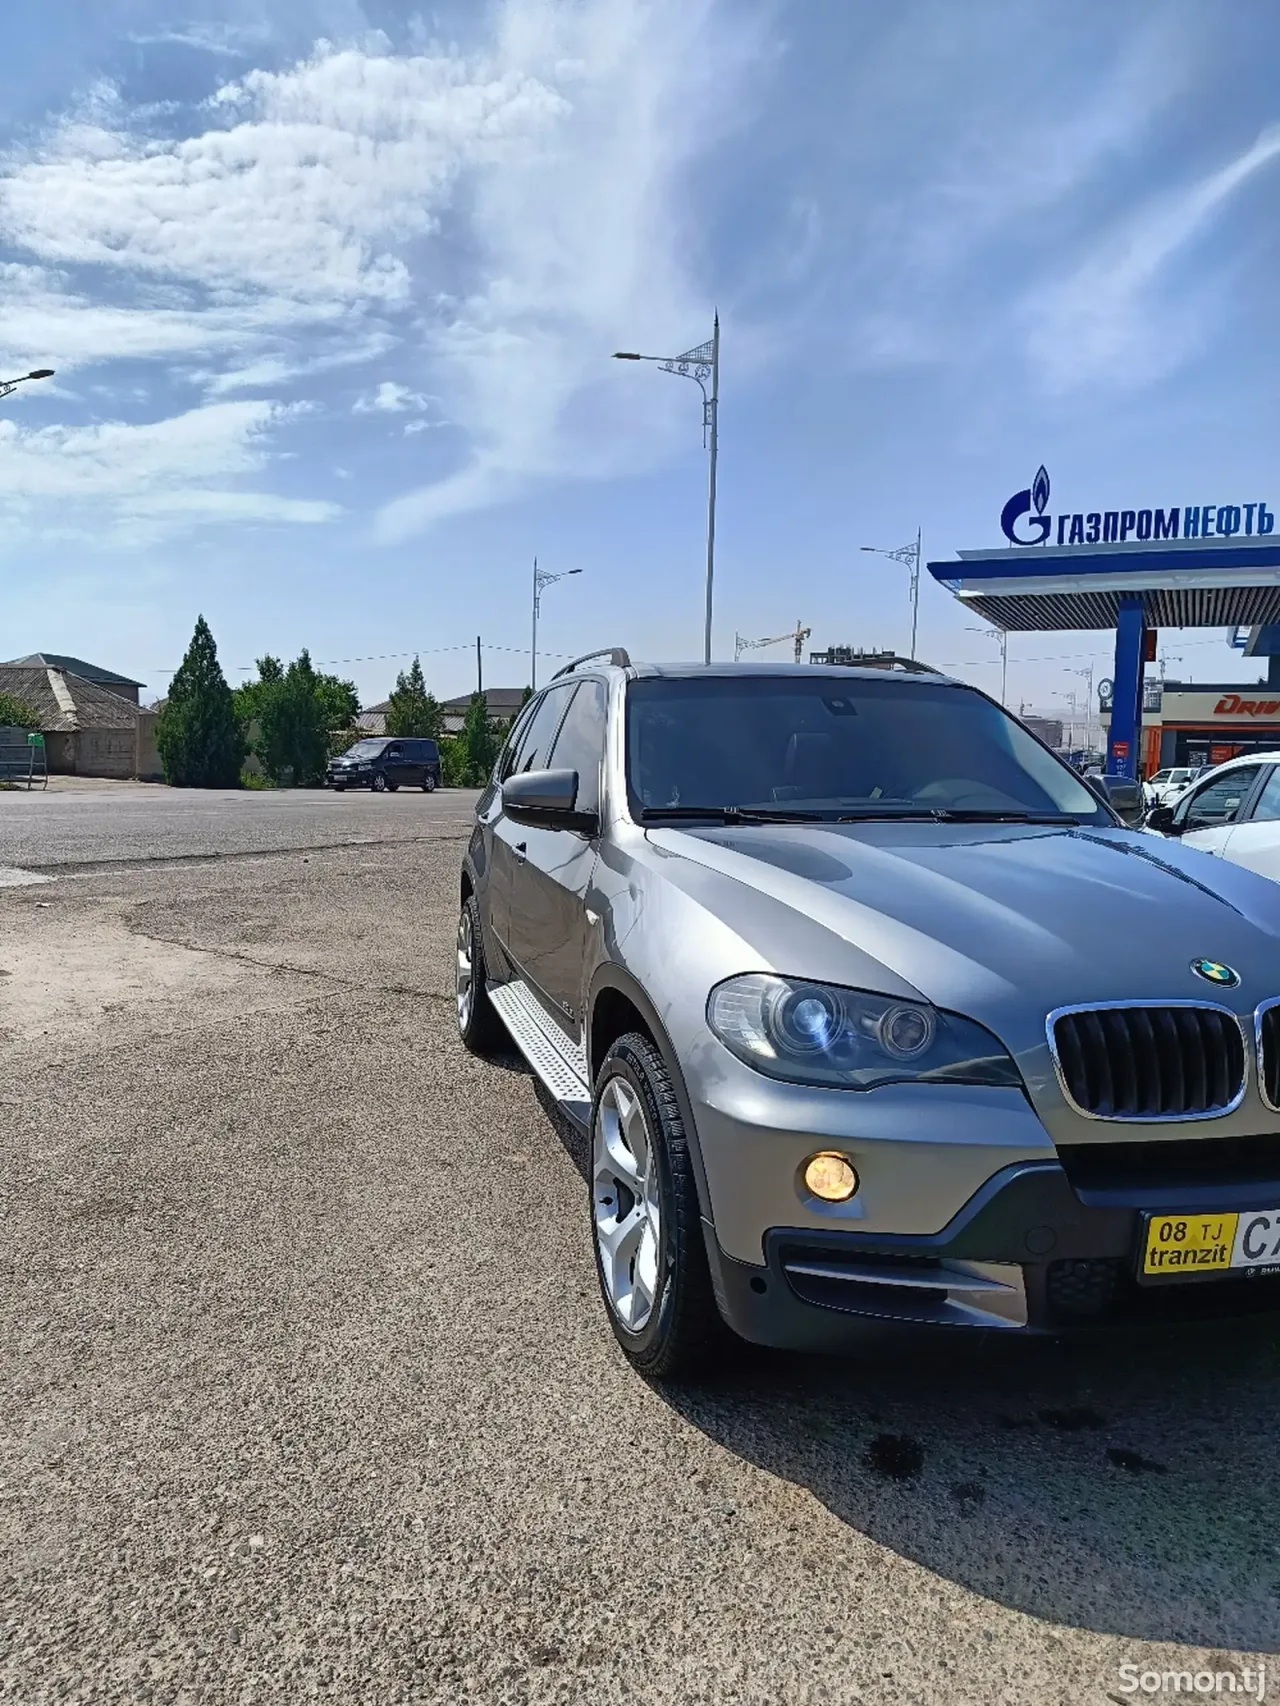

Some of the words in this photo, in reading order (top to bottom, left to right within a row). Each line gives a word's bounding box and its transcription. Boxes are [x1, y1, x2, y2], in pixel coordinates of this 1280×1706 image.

[1159, 1222, 1187, 1242] 08
[1202, 1223, 1223, 1241] TJ
[1149, 1243, 1228, 1267] tranzit
